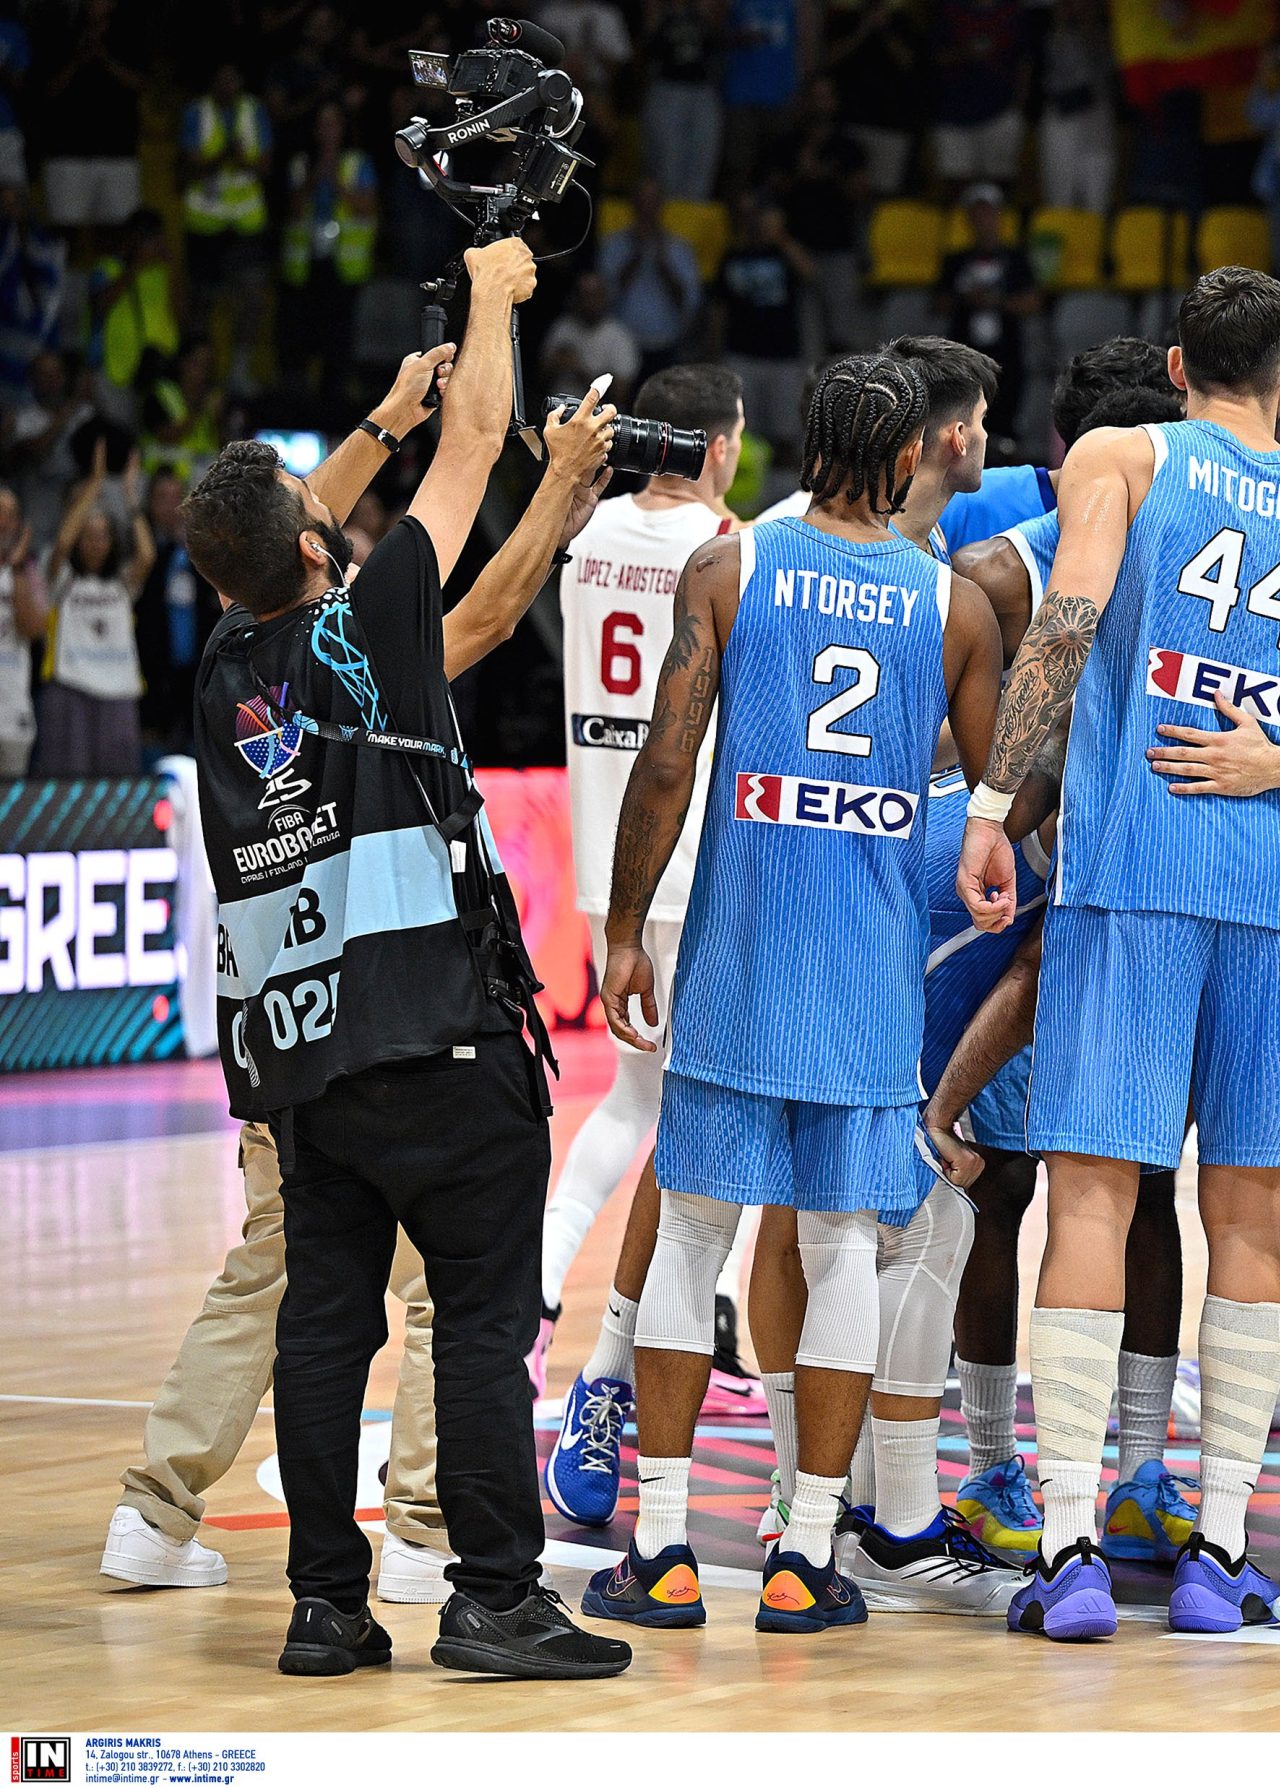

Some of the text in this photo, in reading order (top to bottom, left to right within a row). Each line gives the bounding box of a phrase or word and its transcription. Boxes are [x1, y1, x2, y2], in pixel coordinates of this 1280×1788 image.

[449, 119, 490, 144] RONIN
[775, 568, 919, 627] NTORSEY
[601, 611, 644, 696] 6
[805, 643, 881, 758] 2
[367, 733, 398, 746] MAKE
[398, 737, 422, 750] YOUR
[274, 811, 304, 832] FIBA
[796, 782, 913, 831] EKO
[269, 860, 303, 877] FINLAND
